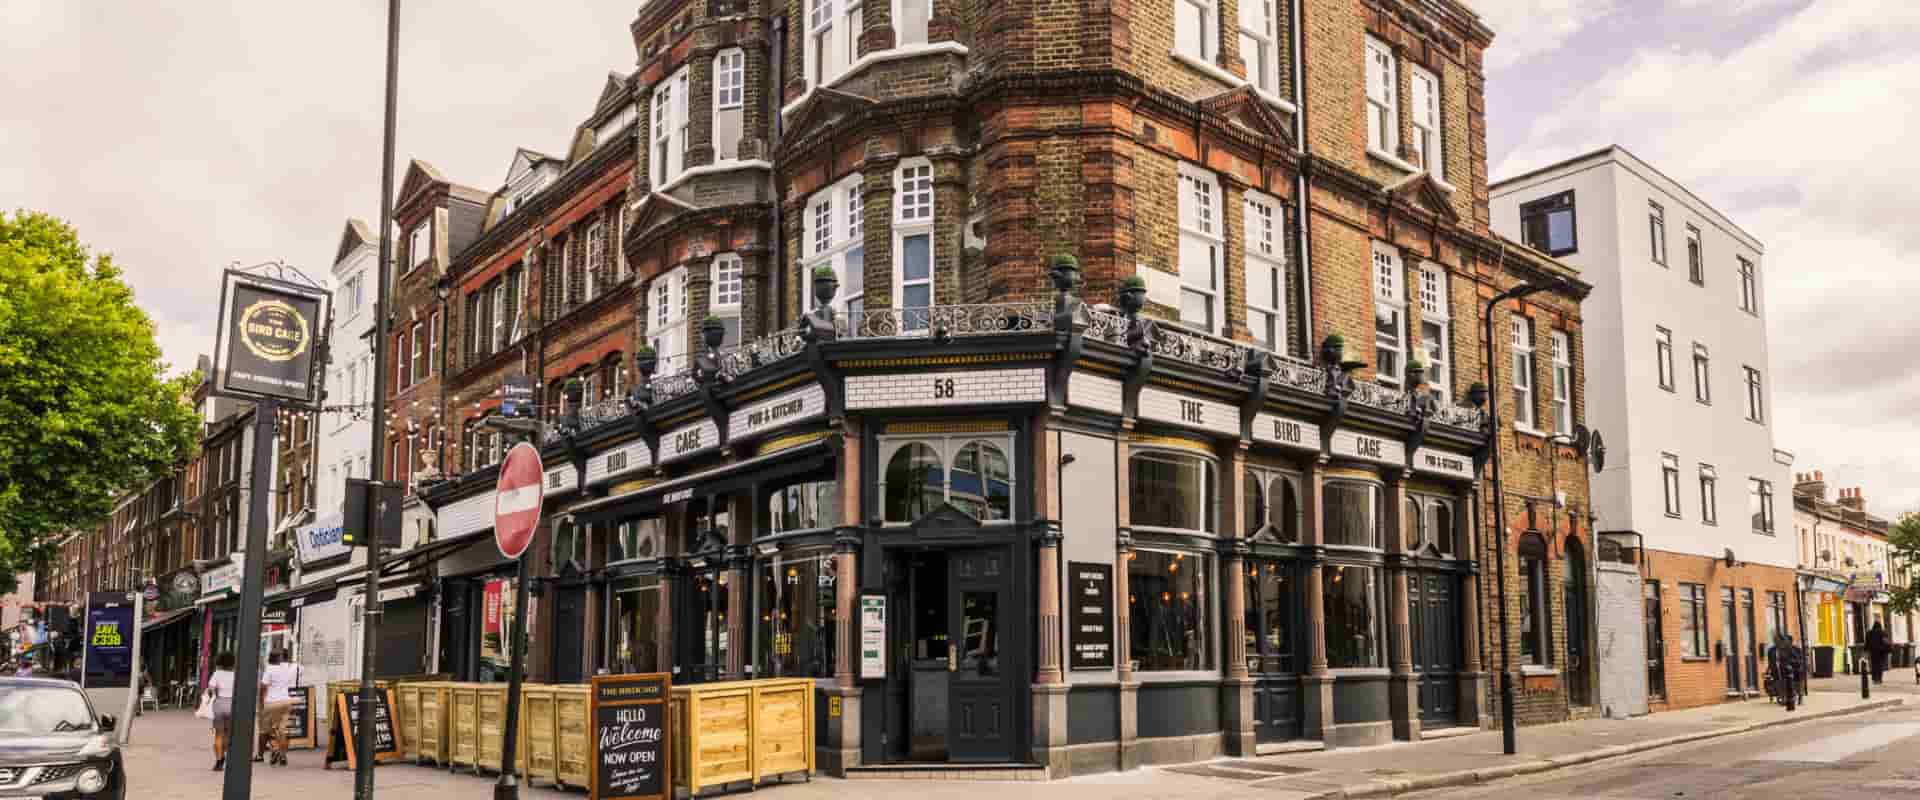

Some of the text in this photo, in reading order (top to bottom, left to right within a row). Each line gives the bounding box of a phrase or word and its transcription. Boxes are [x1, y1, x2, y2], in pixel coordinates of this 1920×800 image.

[247, 322, 301, 341] BIRD CAGE
[935, 378, 954, 399] 58
[748, 411, 763, 428] PUB
[772, 399, 804, 420] KITCHEN
[1179, 399, 1203, 424] THE
[675, 428, 701, 454] CAGE
[1273, 420, 1301, 443] BIRD
[1356, 436, 1382, 459] CAGE
[607, 451, 627, 473] BIRD
[549, 470, 562, 488] THE
[309, 527, 342, 547] Optician
[616, 708, 646, 723] HELLO
[599, 722, 662, 749] Welcome
[604, 751, 656, 766] NOW OPEN
